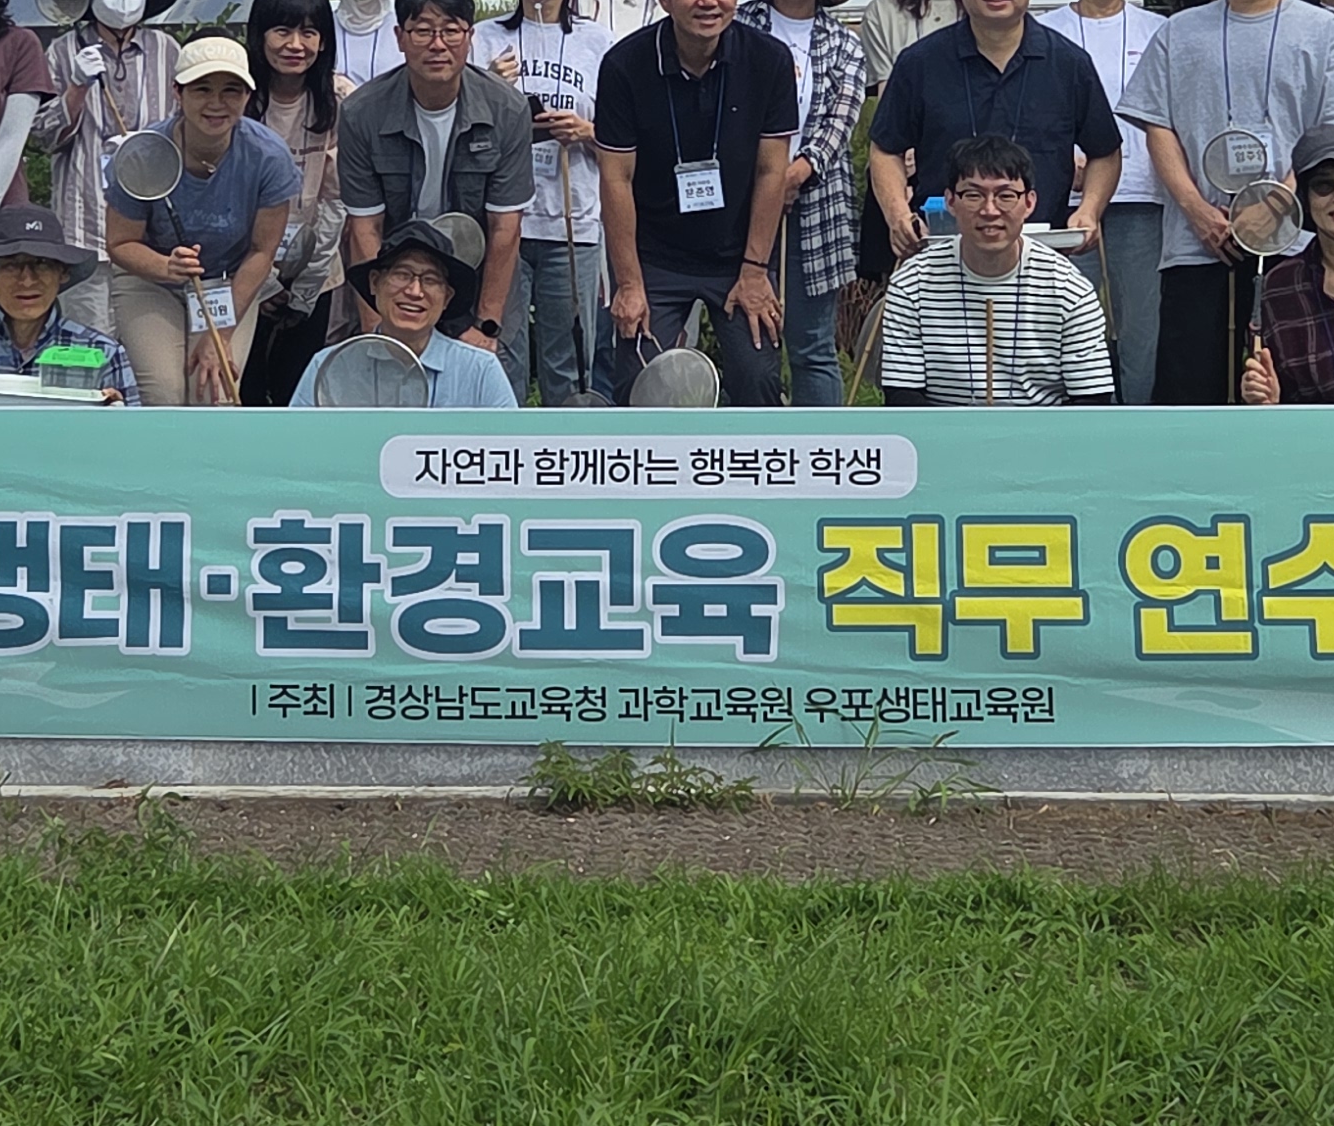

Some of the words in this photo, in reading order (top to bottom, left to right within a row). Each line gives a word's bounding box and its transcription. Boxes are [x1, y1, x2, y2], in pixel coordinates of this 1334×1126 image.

[519, 58, 585, 93] ALISER
[414, 447, 525, 486] 자연과
[533, 447, 680, 486] 함께하는
[689, 447, 800, 486] 행복한
[809, 447, 882, 486] 학생
[818, 514, 1090, 661] 직무
[365, 684, 607, 722] 경상남도교육청
[617, 685, 794, 724] 과학교육원
[803, 686, 1056, 724] 우포생태교육원
